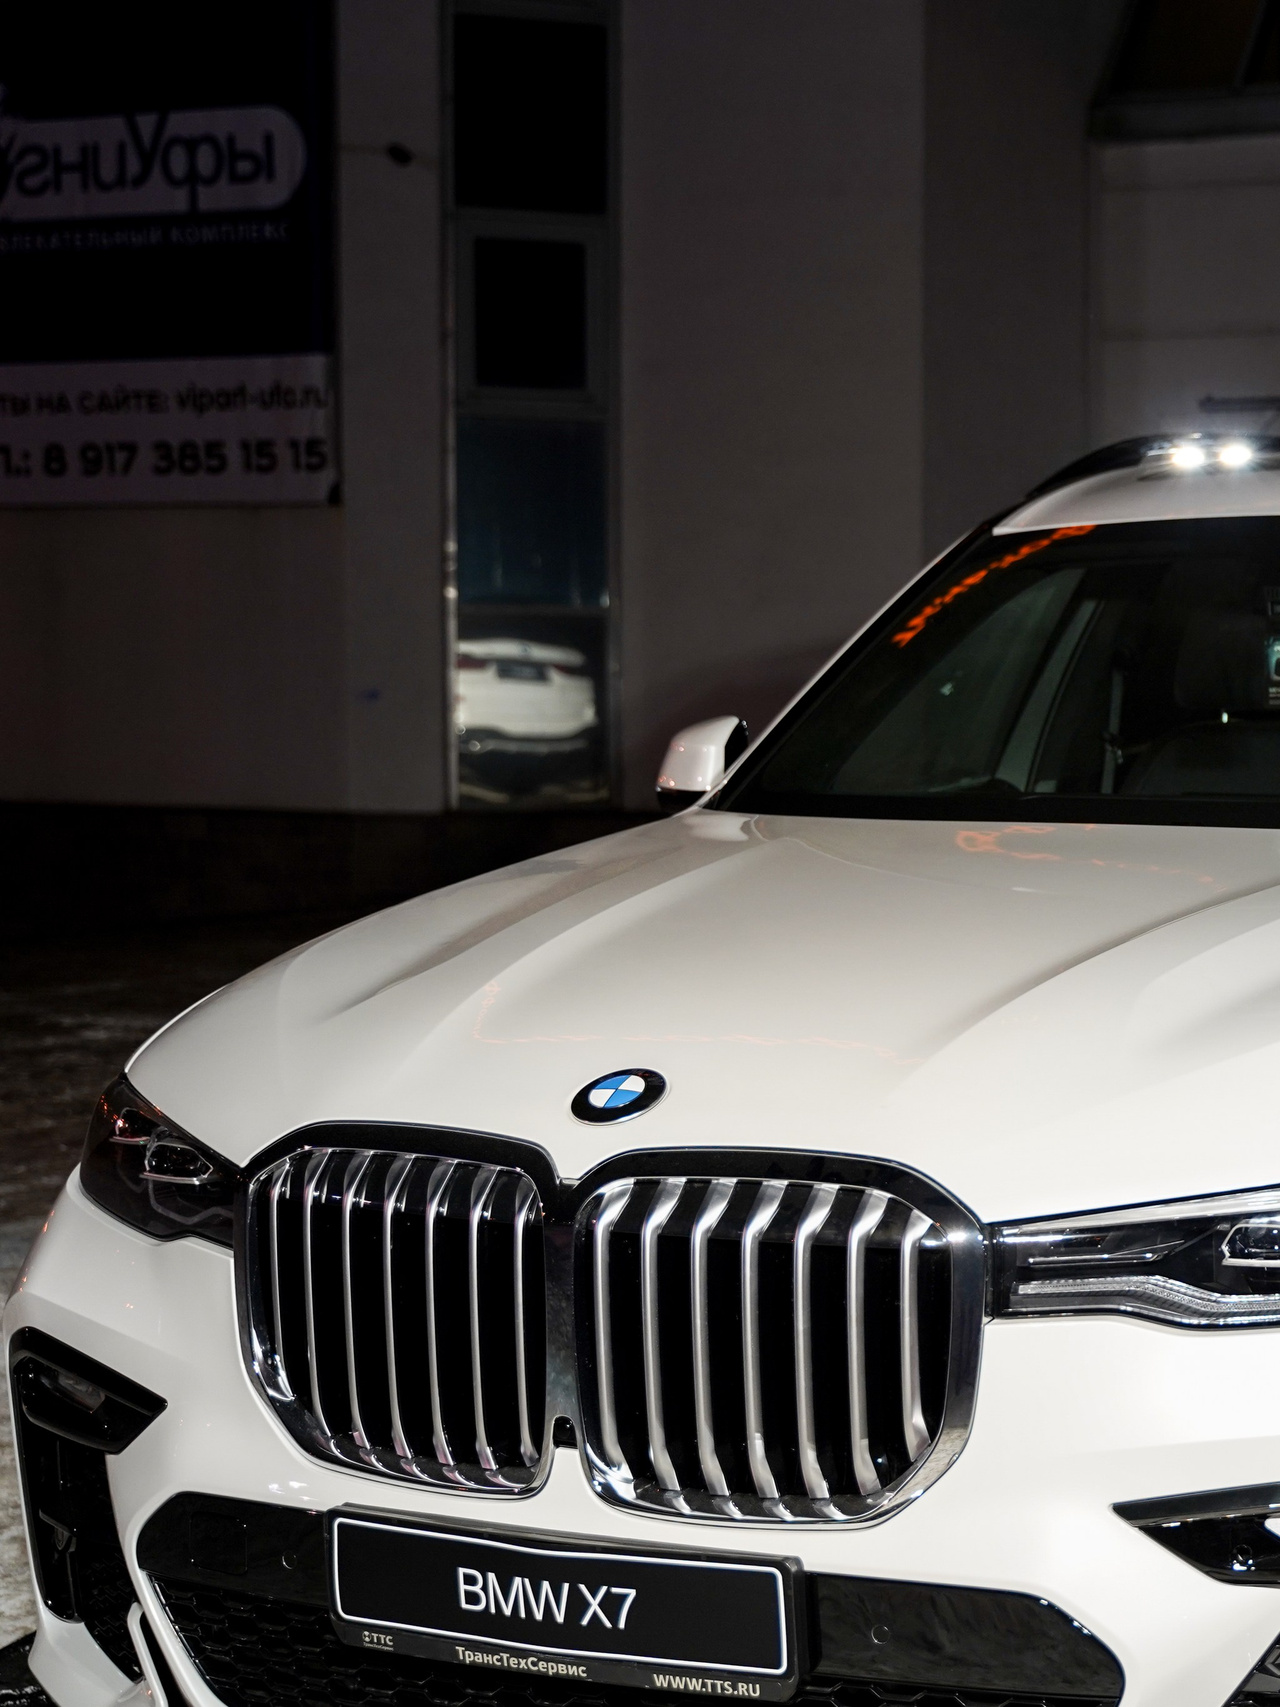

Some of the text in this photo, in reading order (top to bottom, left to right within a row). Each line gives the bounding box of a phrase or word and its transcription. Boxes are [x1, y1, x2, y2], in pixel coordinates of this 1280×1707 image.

[169, 219, 292, 246] КОМПЛЕКС
[37, 391, 71, 414] НА
[44, 442, 67, 477] 8
[80, 442, 138, 477] 917
[240, 439, 278, 474] 15
[289, 437, 327, 473] 15
[457, 1566, 637, 1631] BMW X7
[371, 1632, 394, 1646] ТТС
[455, 1646, 588, 1678] ТрансТехСервис
[653, 1673, 761, 1698] WWW.TTS.RU
